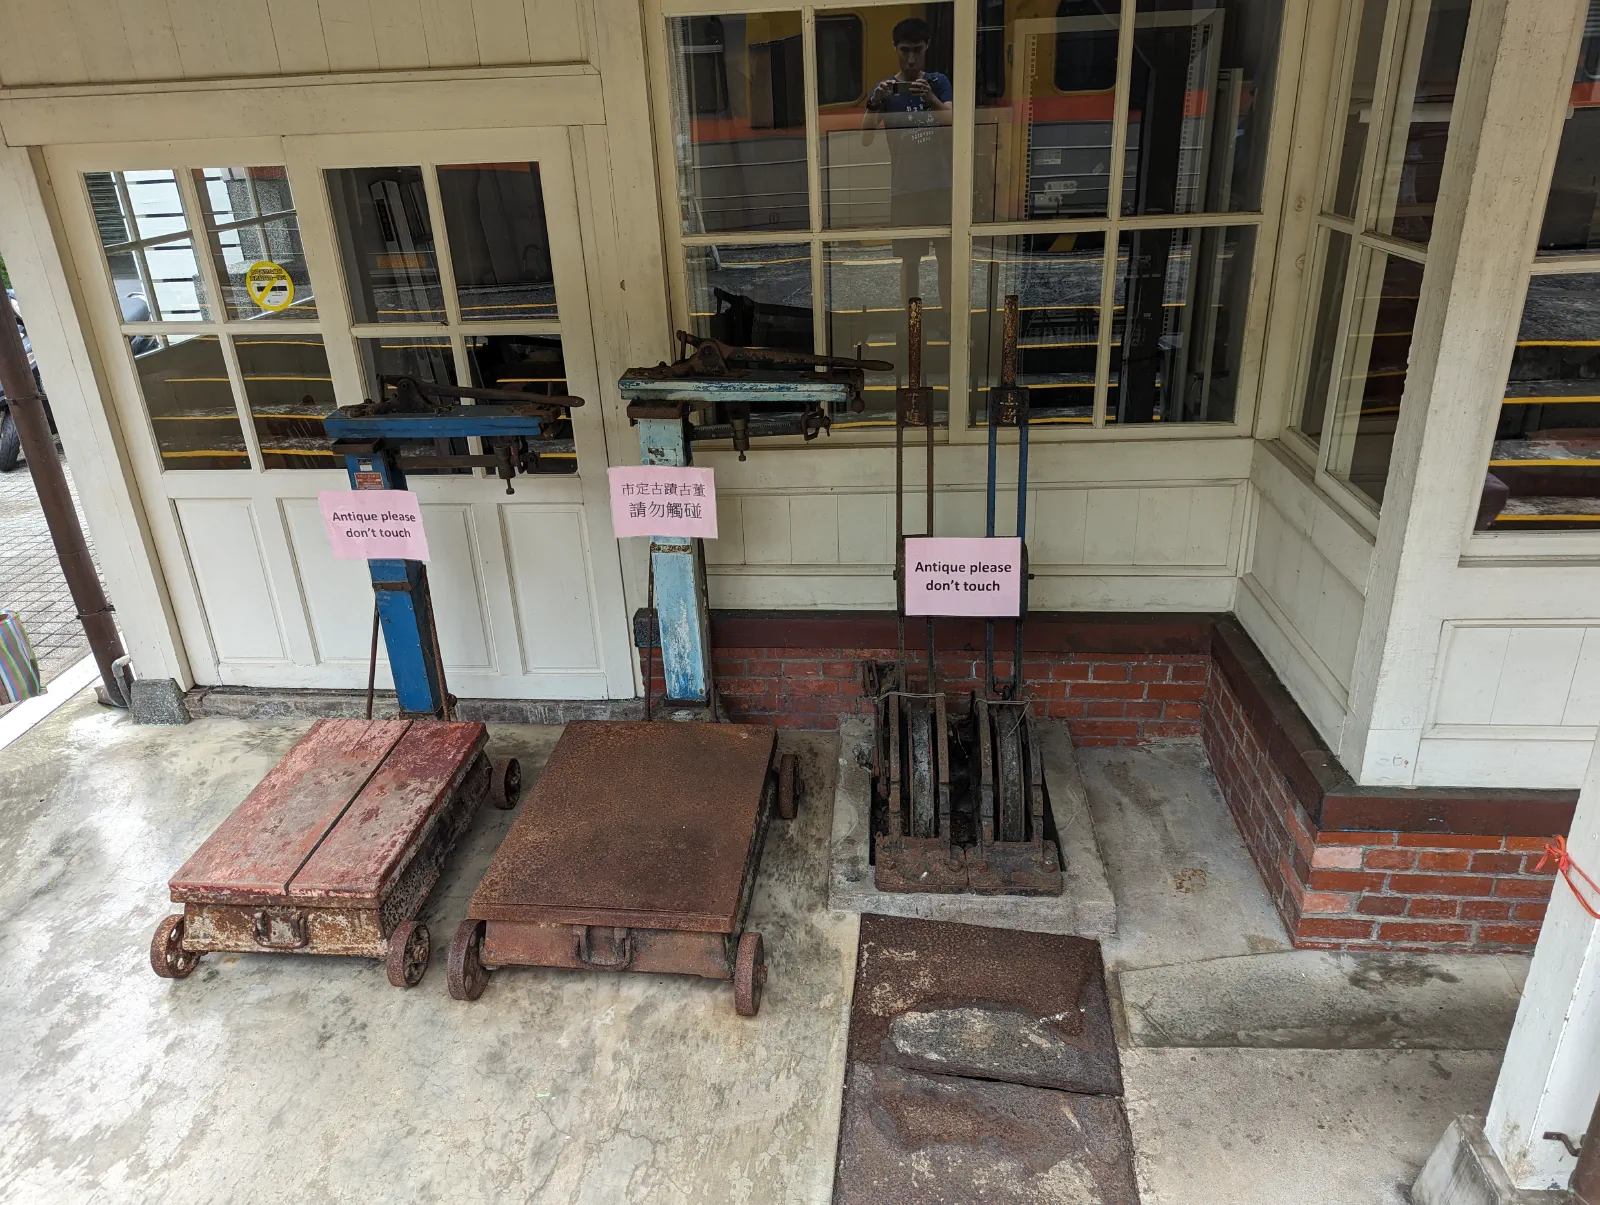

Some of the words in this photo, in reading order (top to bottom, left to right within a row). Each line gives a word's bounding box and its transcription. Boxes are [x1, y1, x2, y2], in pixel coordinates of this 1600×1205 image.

[620, 481, 706, 498] 市定古蹟古董
[332, 511, 378, 523] Antique
[380, 510, 417, 523] please
[628, 501, 703, 519] 請勿觸碰
[345, 528, 377, 538] don’t
[379, 528, 412, 538] touch
[914, 561, 966, 575] Antique
[969, 561, 1012, 575] please
[925, 580, 960, 591] don’t
[963, 580, 1001, 592] touch
